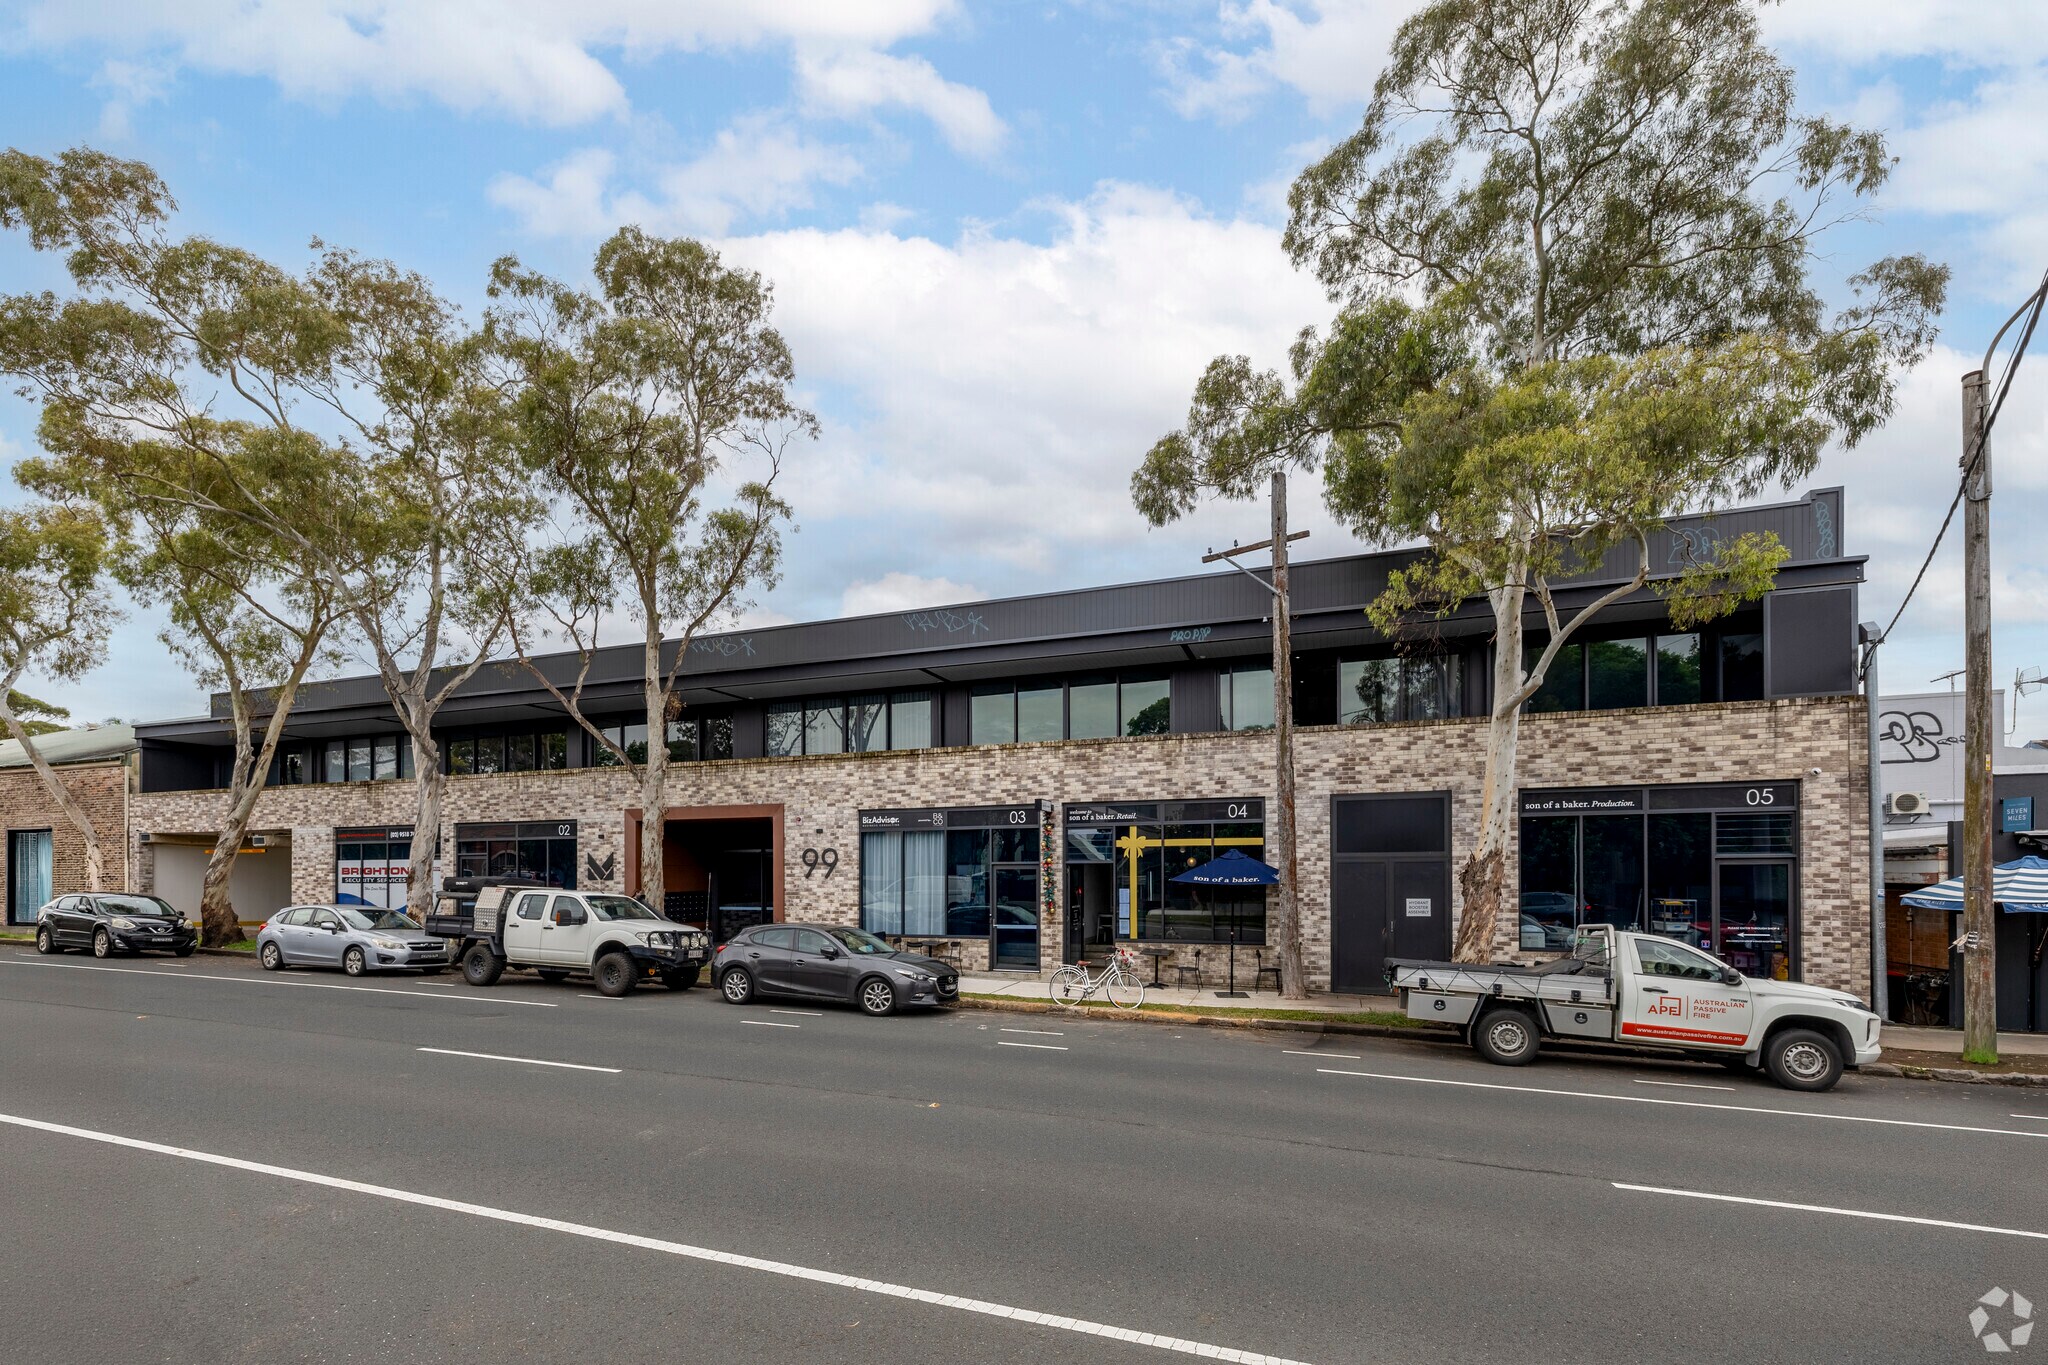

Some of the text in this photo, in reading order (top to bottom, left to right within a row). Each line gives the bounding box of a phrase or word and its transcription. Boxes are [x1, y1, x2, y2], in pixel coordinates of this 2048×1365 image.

[1746, 788, 1774, 805] 05
[1562, 800, 1590, 808] baker.
[1228, 804, 1248, 818] 04
[2006, 807, 2028, 815] SEVEN
[1009, 811, 1026, 823] 03
[558, 825, 570, 835] 02
[1693, 999, 1745, 1009] AUSTRALIAN
[1693, 1006, 1727, 1014] PASSIVE
[1693, 1012, 1711, 1020] FIRE
[1636, 1027, 1743, 1042] www.australianpassivefire.com.au
